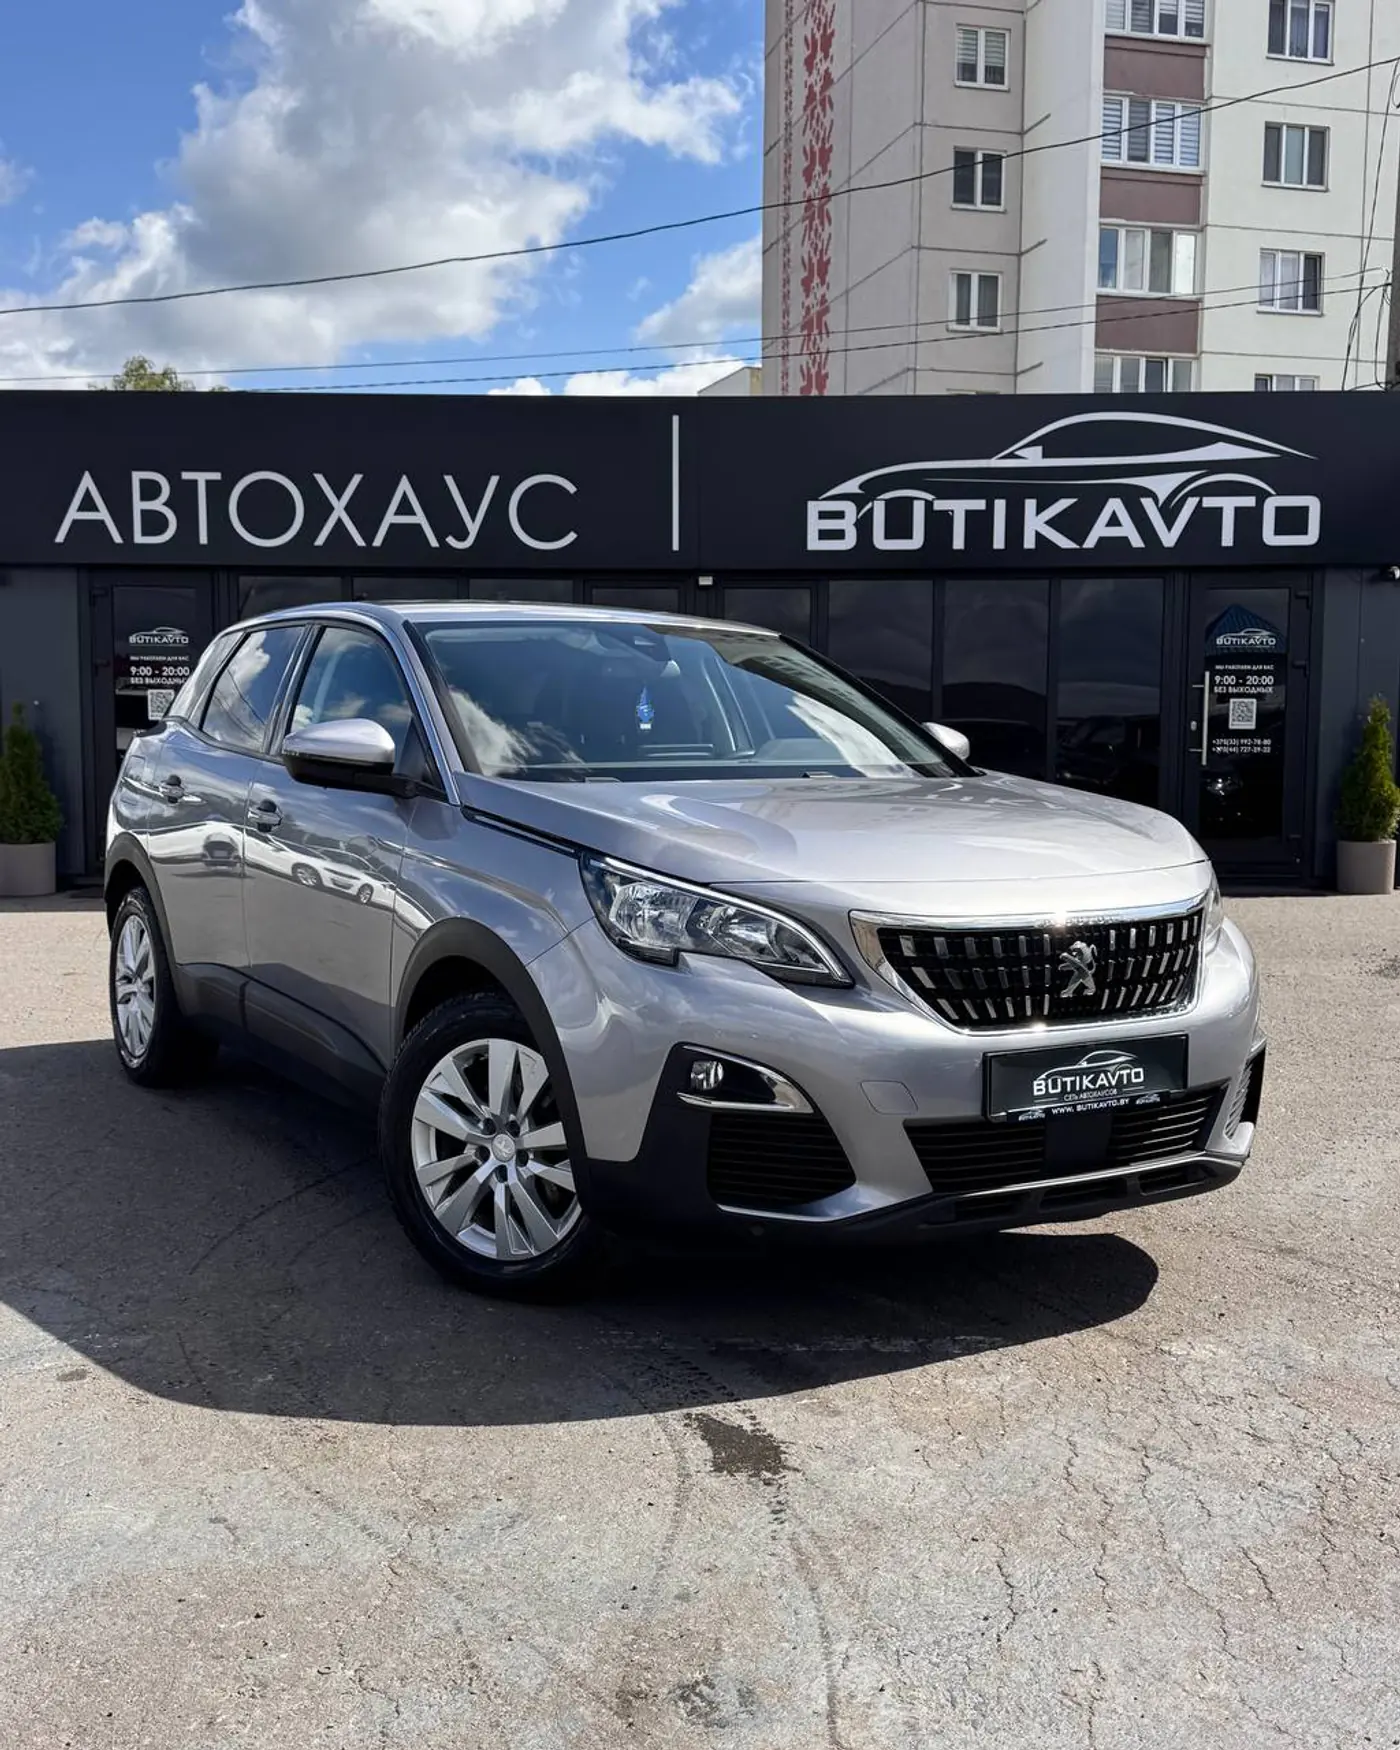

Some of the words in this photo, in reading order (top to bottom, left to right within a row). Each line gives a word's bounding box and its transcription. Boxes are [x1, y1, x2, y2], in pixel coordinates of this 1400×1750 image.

[55, 470, 579, 550] АВТОХАУС
[806, 494, 1322, 551] BUTIKAVTO
[1216, 637, 1276, 645] BUTIKAVTO
[130, 666, 153, 676] 9:00
[162, 667, 190, 676] 20:00
[1214, 676, 1236, 685] 9:00
[1246, 676, 1274, 685] 20:00
[1033, 1068, 1144, 1096] BUTIKAVTO
